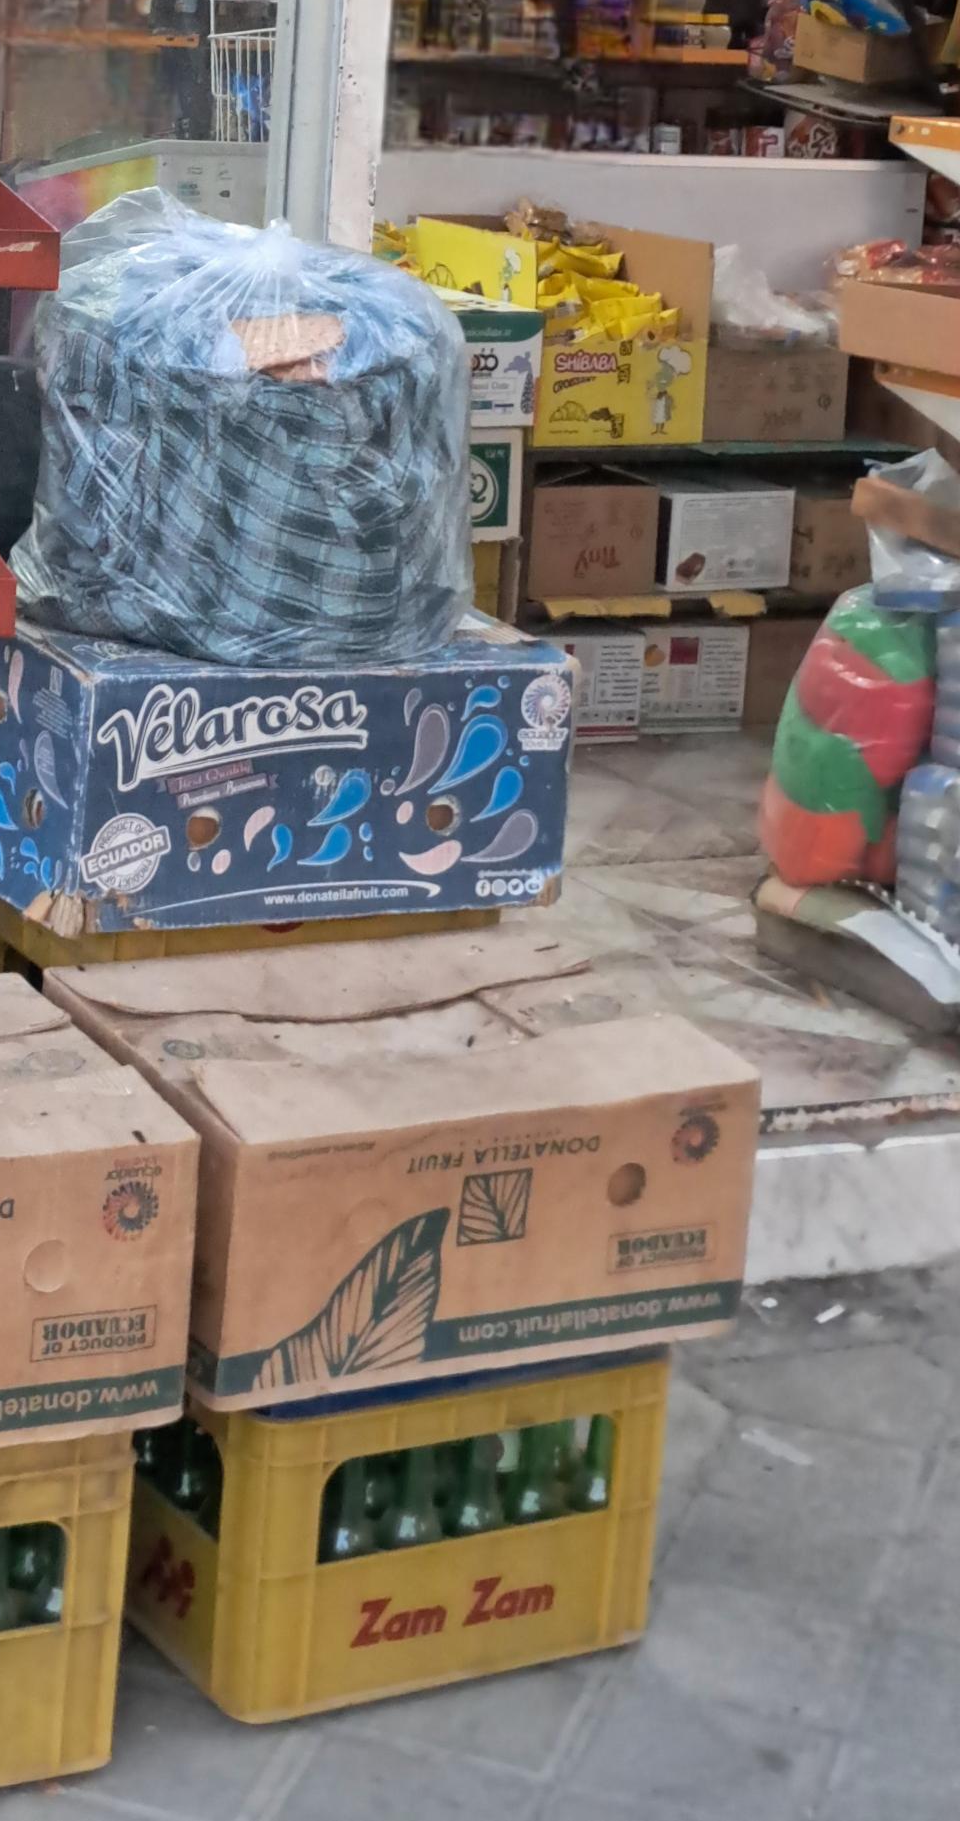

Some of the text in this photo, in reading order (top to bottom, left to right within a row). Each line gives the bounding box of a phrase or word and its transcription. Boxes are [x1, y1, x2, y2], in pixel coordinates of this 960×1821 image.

[97, 683, 368, 791] Velarosa
[87, 833, 166, 874] ECUADOR
[406, 1133, 602, 1174] DONATELLA FRUIT
[41, 1312, 149, 1342] ECUADOR
[458, 1290, 722, 1344] www.donatellafruit.com
[40, 1331, 148, 1357] PRODUCT OF
[350, 1576, 556, 1648] Zam Zam
